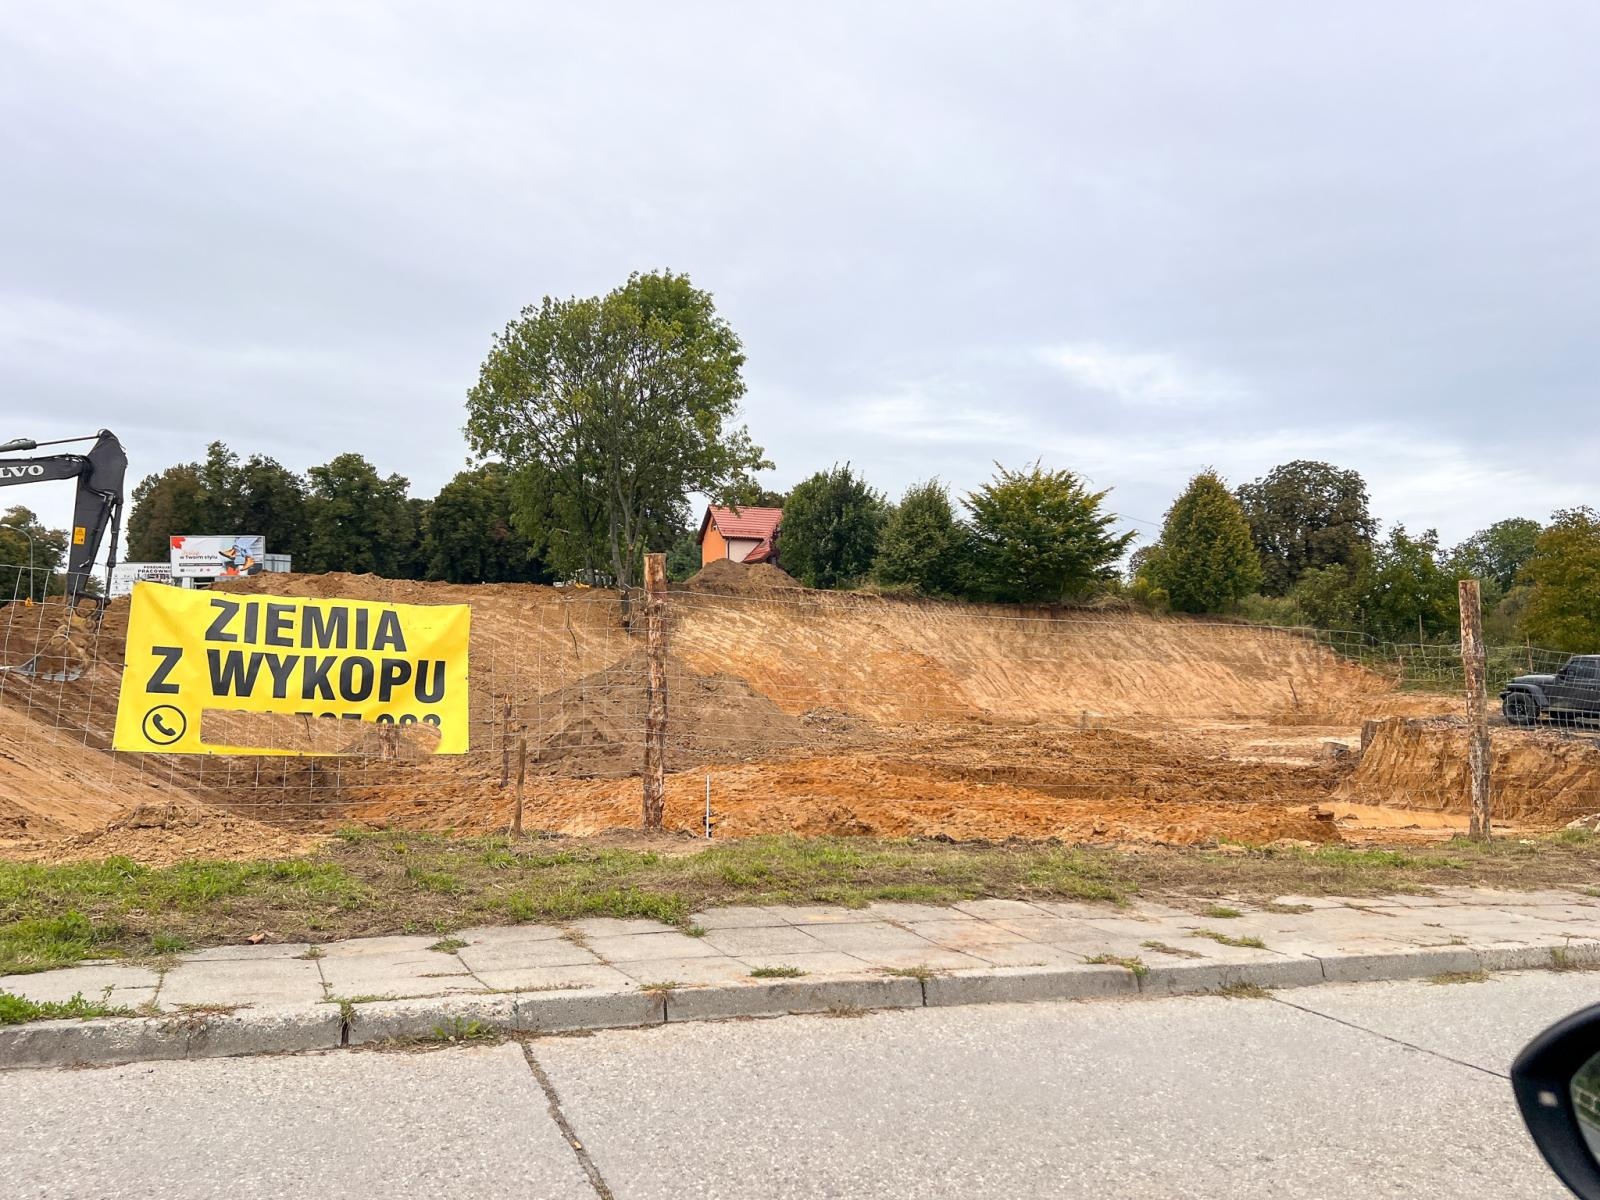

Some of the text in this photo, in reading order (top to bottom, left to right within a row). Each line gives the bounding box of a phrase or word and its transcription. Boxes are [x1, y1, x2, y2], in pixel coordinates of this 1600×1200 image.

[205, 599, 407, 652] ZIEMIA
[146, 645, 446, 703] Z WYKOPU
